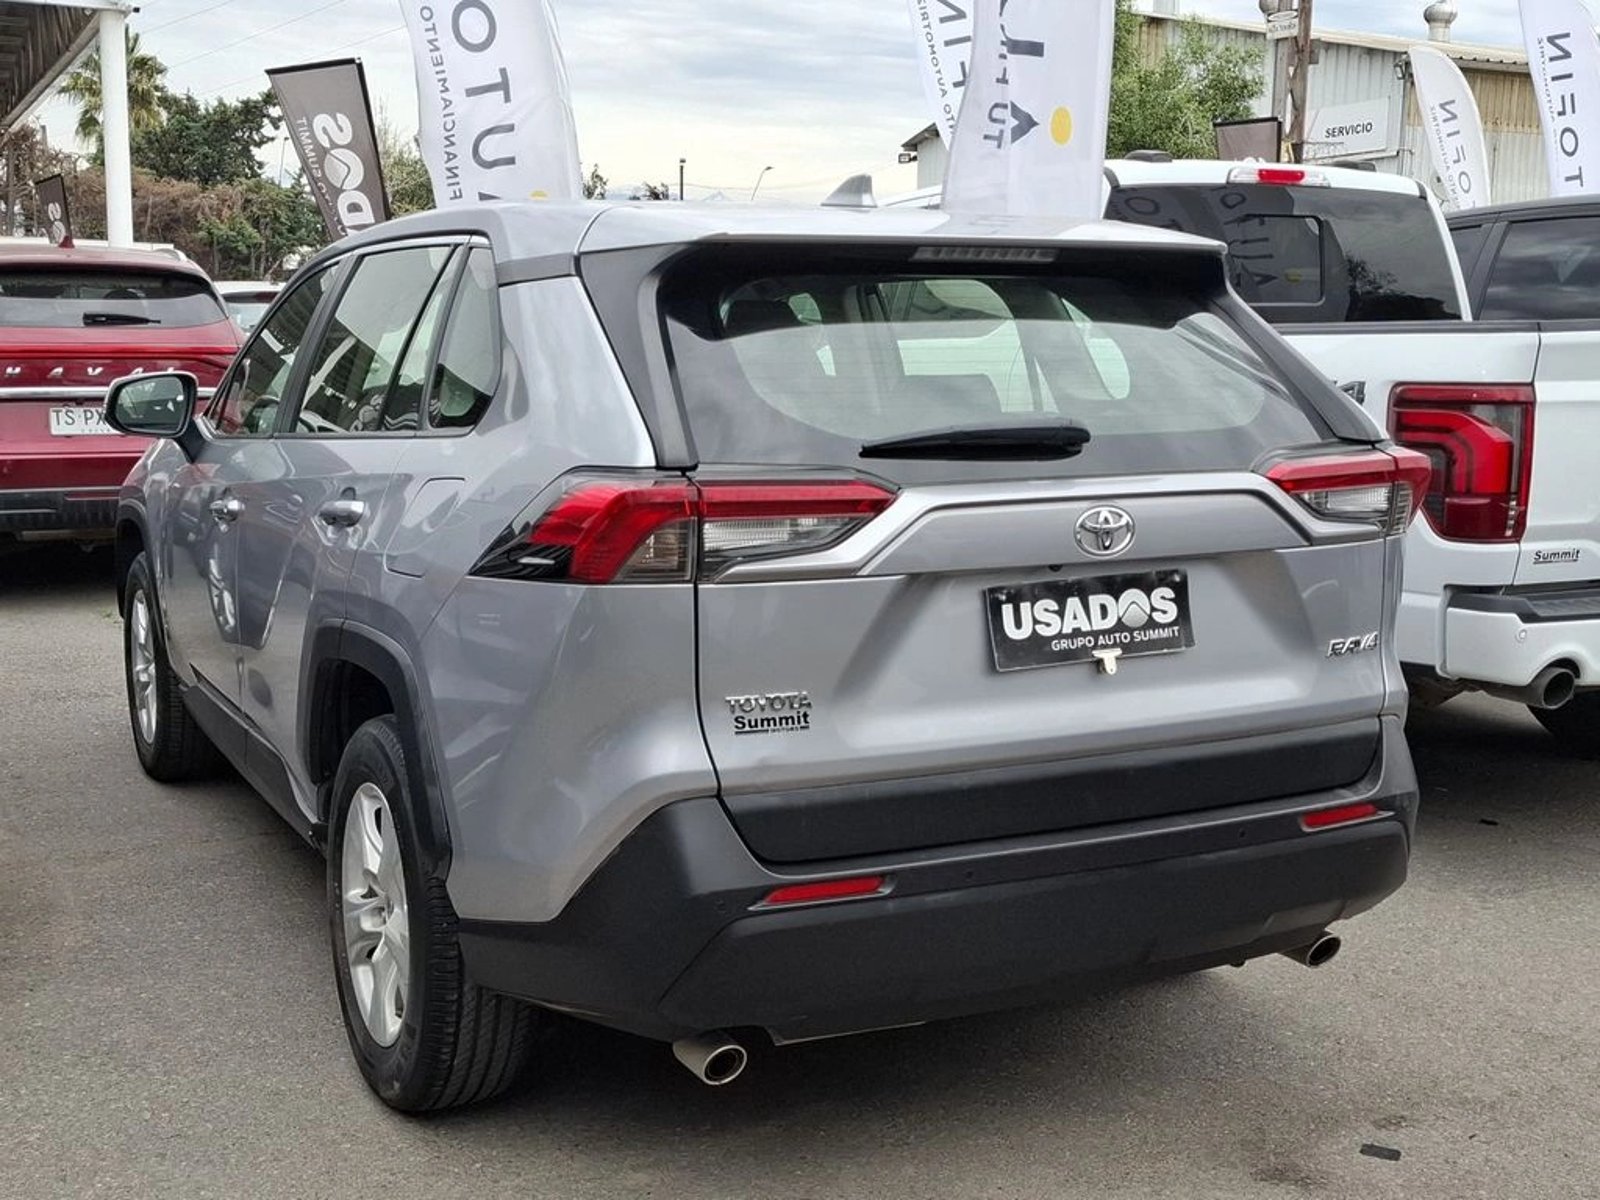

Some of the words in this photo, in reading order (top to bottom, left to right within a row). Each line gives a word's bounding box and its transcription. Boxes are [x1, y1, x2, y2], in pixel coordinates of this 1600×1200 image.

[1325, 122, 1373, 139] SERVICIO
[1533, 548, 1580, 561] Summit
[1001, 586, 1178, 640] USADOS
[1051, 635, 1095, 651] GRUPO
[1097, 632, 1131, 647] AUTO
[1133, 626, 1180, 642] SUMMIT
[1326, 631, 1378, 658] RAV4
[725, 691, 812, 714] TOYOTA
[734, 710, 809, 730] Summit
